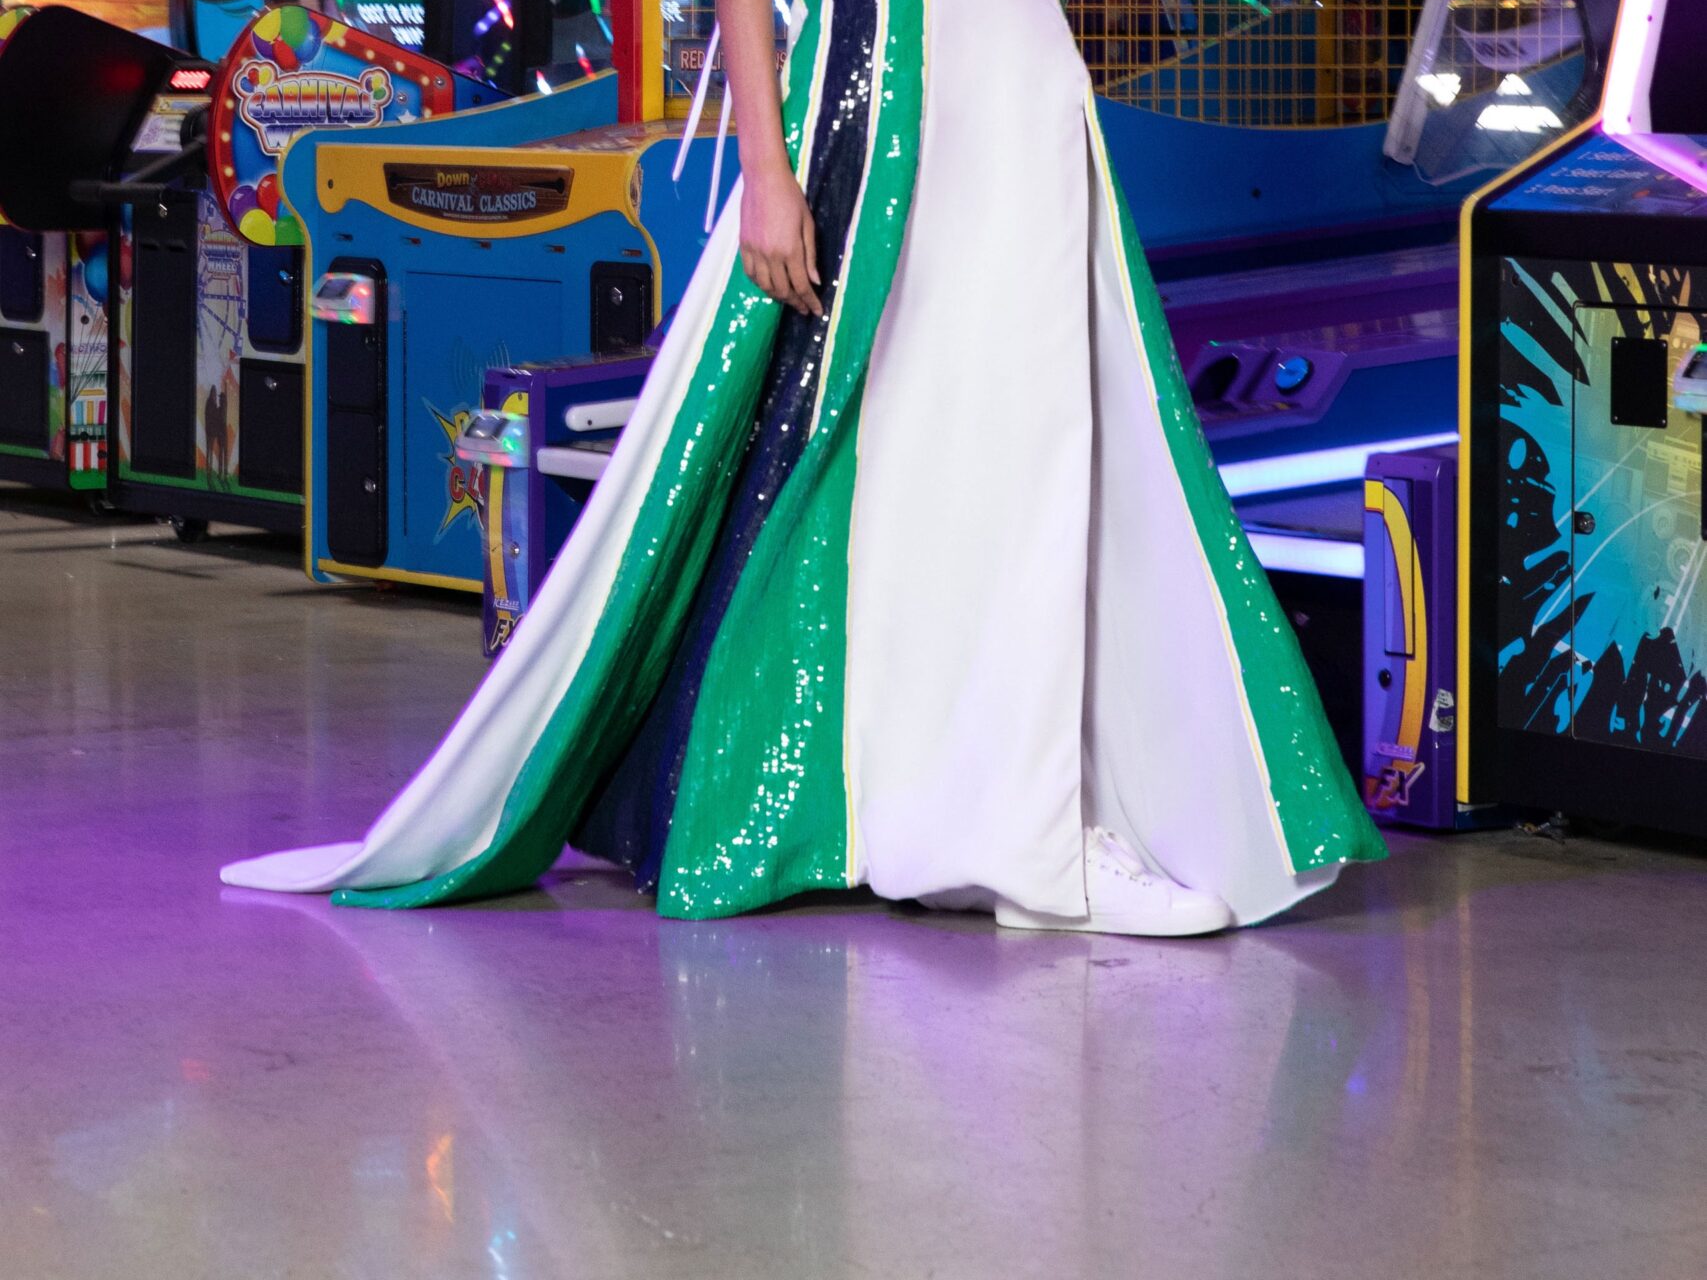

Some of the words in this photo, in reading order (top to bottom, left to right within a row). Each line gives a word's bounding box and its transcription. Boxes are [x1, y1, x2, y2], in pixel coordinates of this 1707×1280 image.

[680, 49, 705, 70] RED
[248, 78, 376, 124] CARNIVAL
[411, 186, 474, 212] CARNIVAL
[479, 191, 537, 213] CLASSICS
